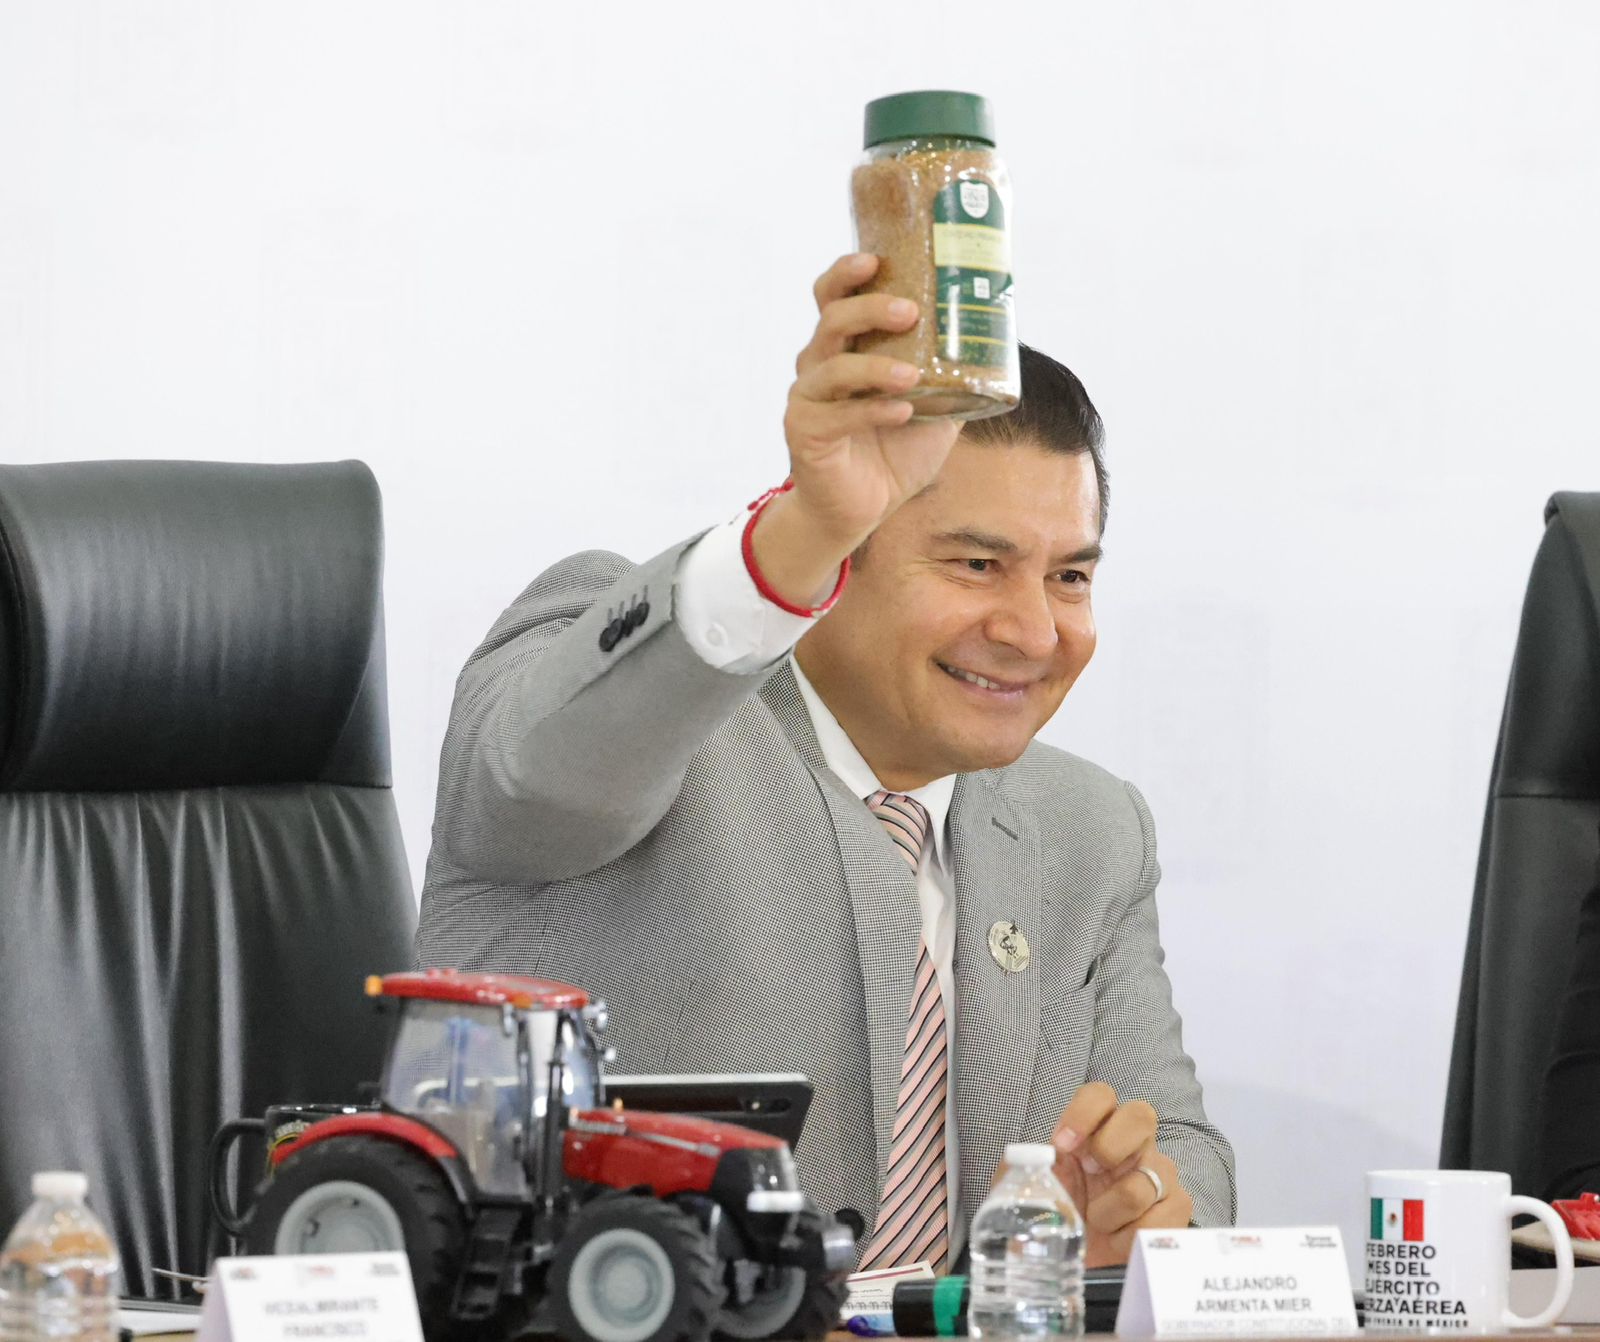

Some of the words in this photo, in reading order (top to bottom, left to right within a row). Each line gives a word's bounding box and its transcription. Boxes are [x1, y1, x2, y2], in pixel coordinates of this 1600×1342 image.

[1366, 1243, 1436, 1259] FEBRERO
[1368, 1260, 1391, 1275] MES
[1395, 1261, 1431, 1276] DEL
[1203, 1275, 1298, 1292] ALEJANDRO
[1195, 1298, 1269, 1313] ARMENTA
[1275, 1297, 1312, 1312] MIER
[1399, 1296, 1466, 1314] AÉREA
